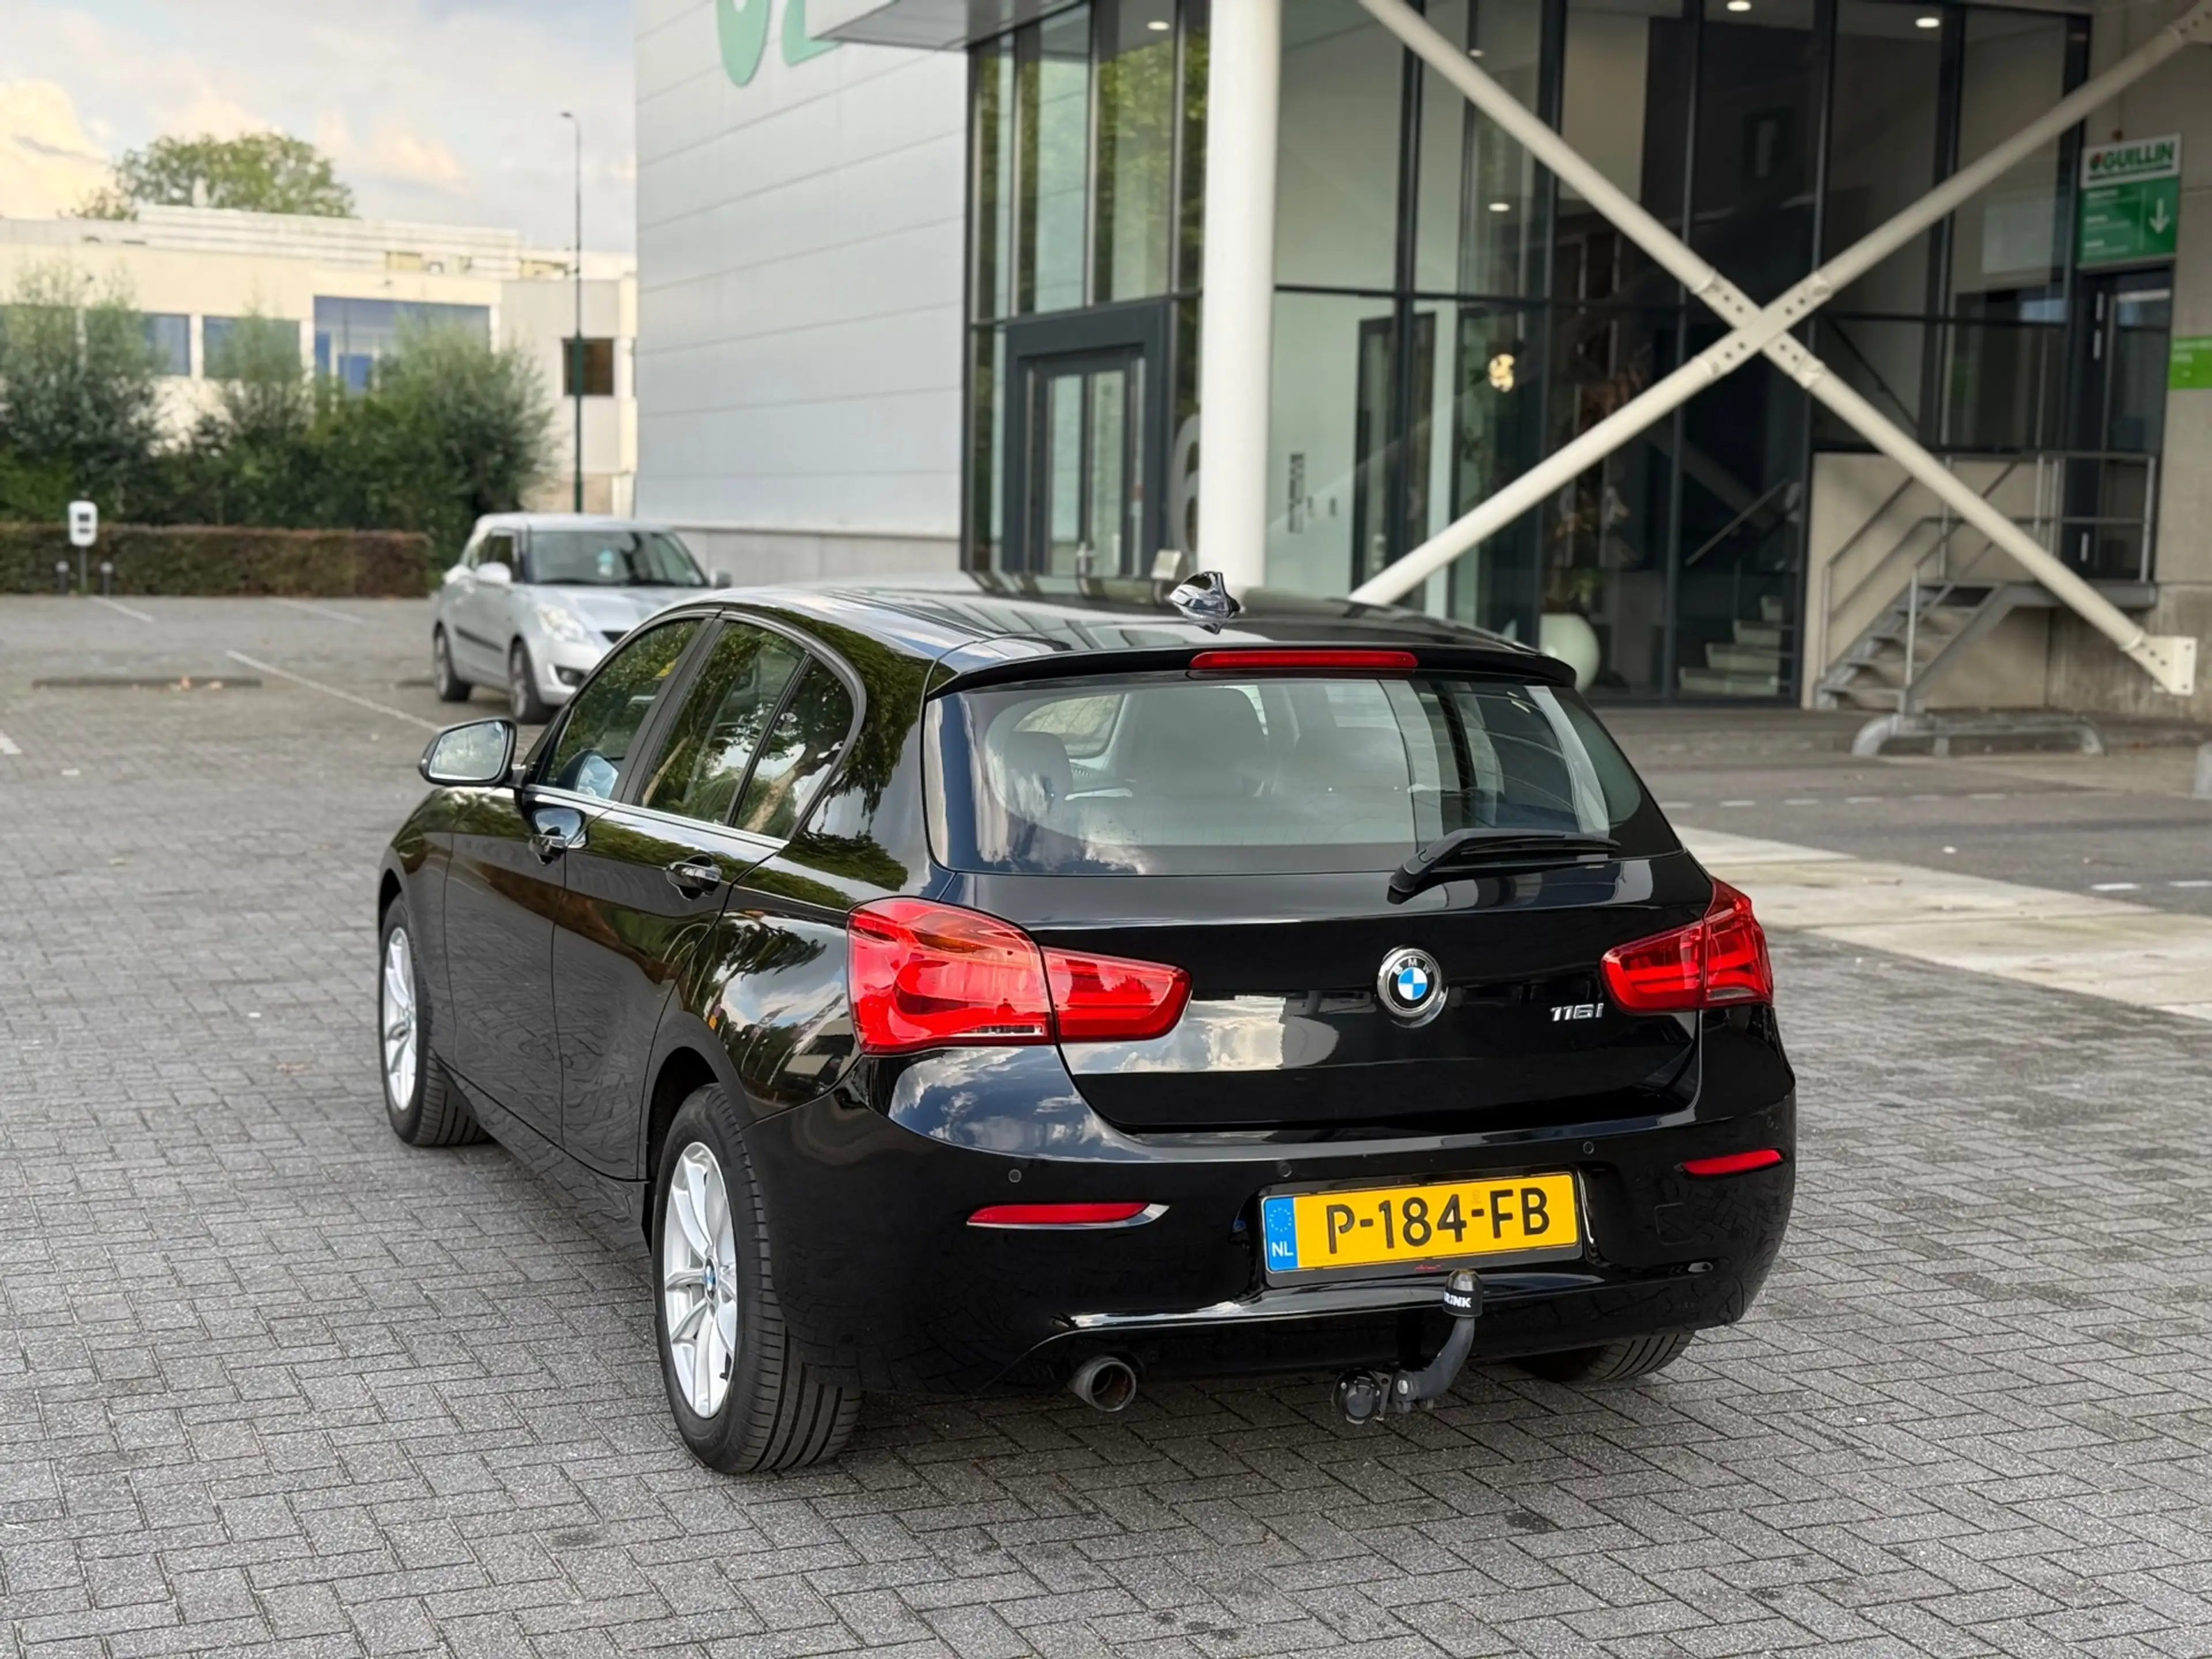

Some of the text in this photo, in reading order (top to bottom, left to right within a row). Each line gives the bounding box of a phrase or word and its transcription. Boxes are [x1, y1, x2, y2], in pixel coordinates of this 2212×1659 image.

[1393, 957, 1432, 976] BMW
[1550, 1002, 1604, 1021] 116i
[1325, 1187, 1550, 1254] P-184-FB
[1271, 1240, 1294, 1257] NL
